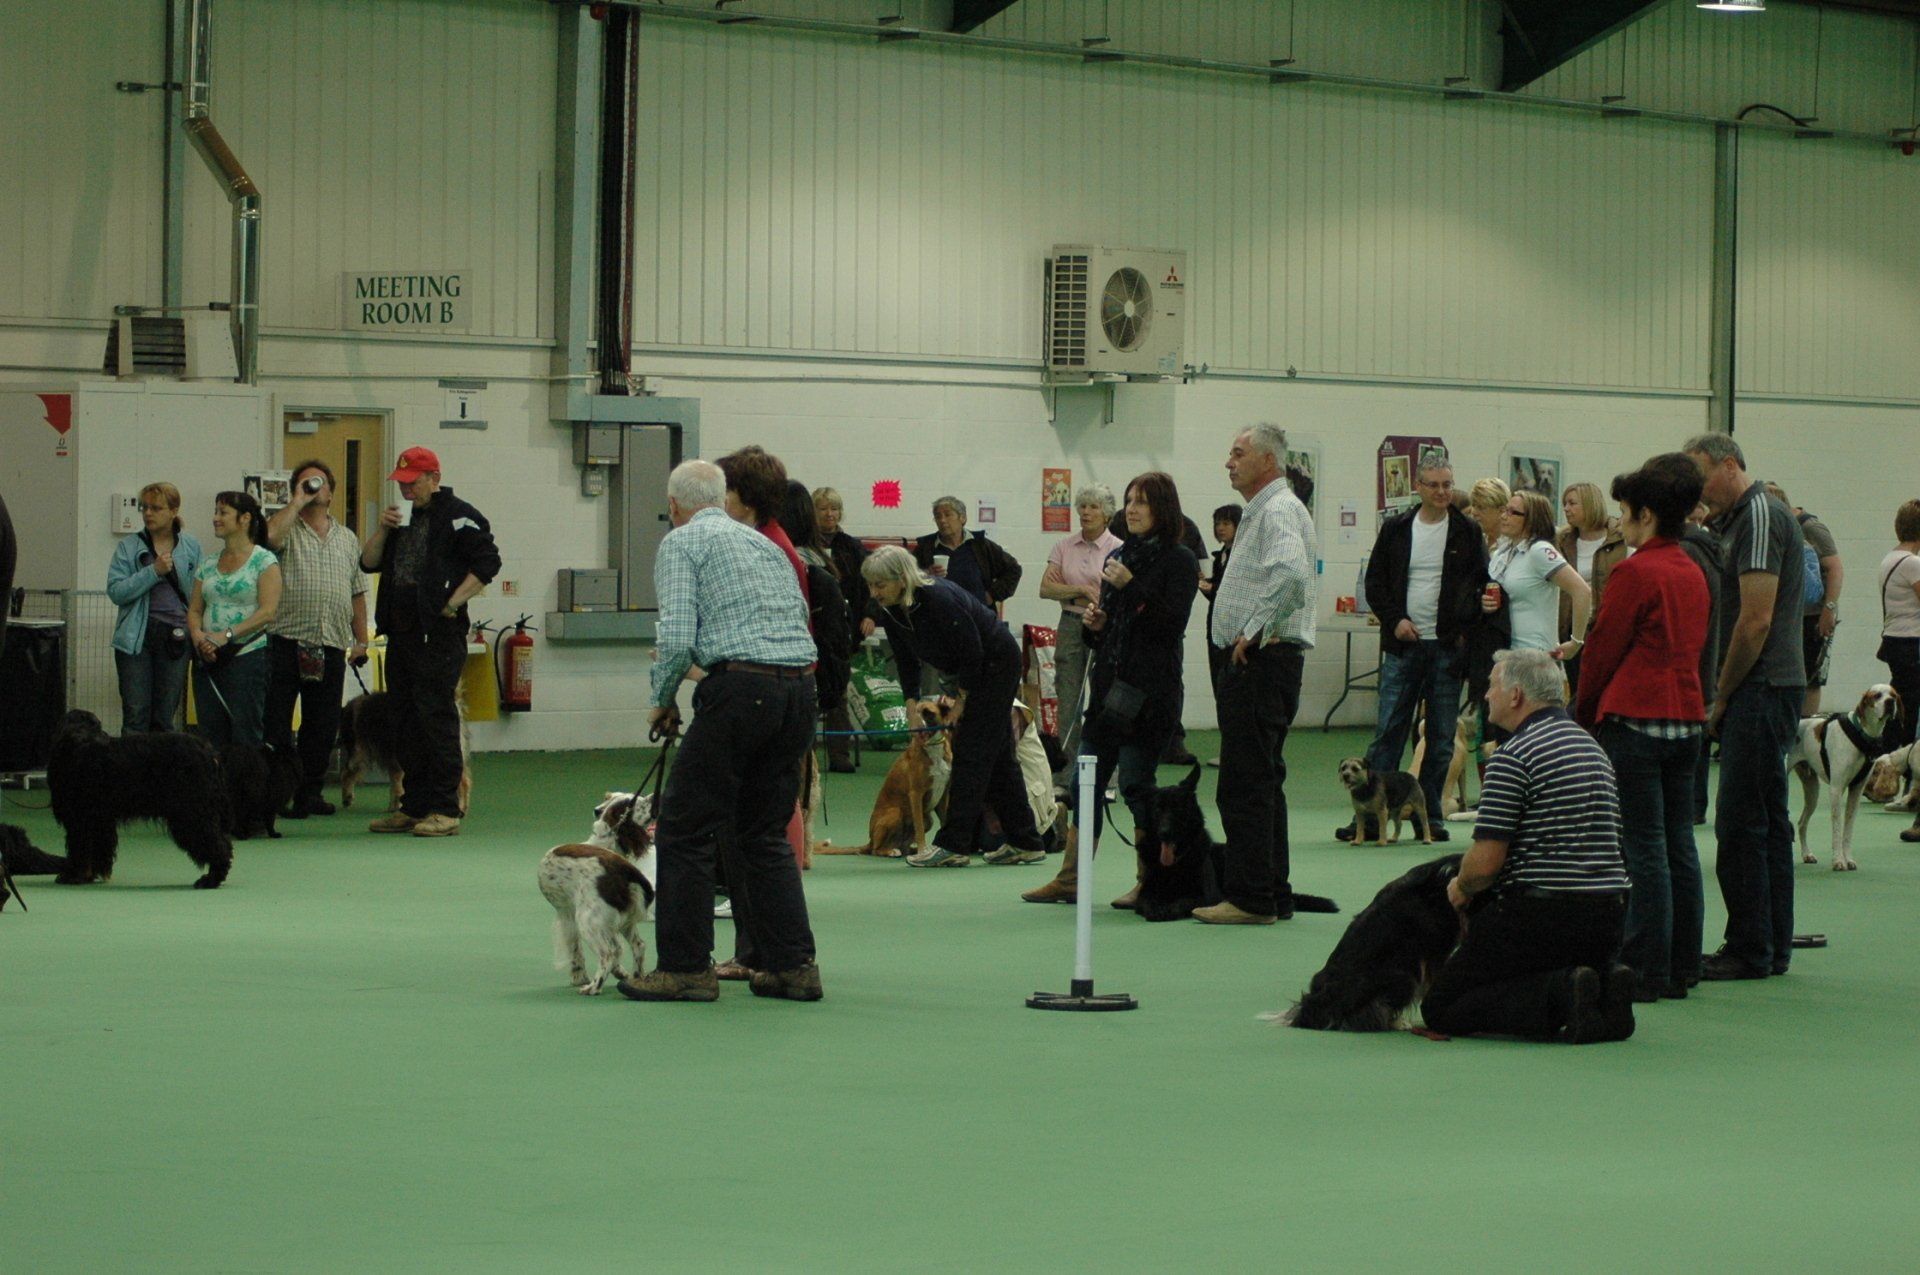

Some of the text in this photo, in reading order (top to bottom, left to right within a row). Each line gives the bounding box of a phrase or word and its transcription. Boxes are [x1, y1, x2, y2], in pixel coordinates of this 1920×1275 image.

[356, 275, 461, 298] MEETING
[362, 301, 454, 324] ROOM B
[1544, 547, 1558, 561] 3
